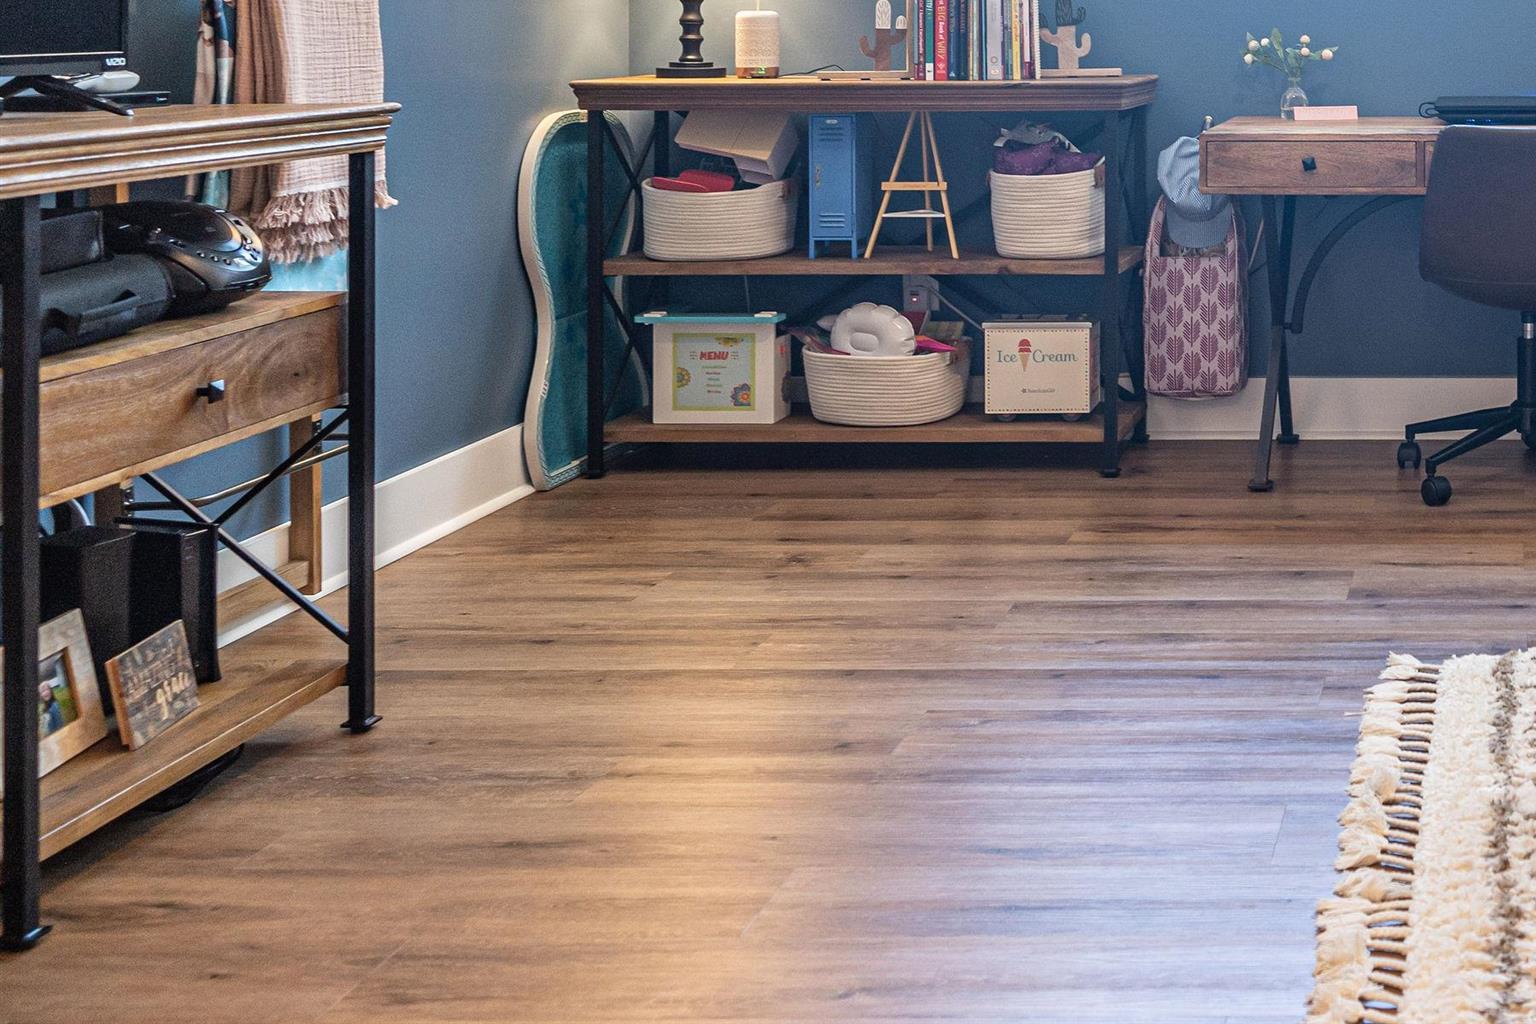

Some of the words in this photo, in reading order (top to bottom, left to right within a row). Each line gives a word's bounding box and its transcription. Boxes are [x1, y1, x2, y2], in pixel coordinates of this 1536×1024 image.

[937, 6, 946, 21] BIG
[937, 41, 946, 60] WHY
[699, 351, 729, 360] MENU
[996, 350, 1017, 363] Ice
[1032, 349, 1078, 363] Cream
